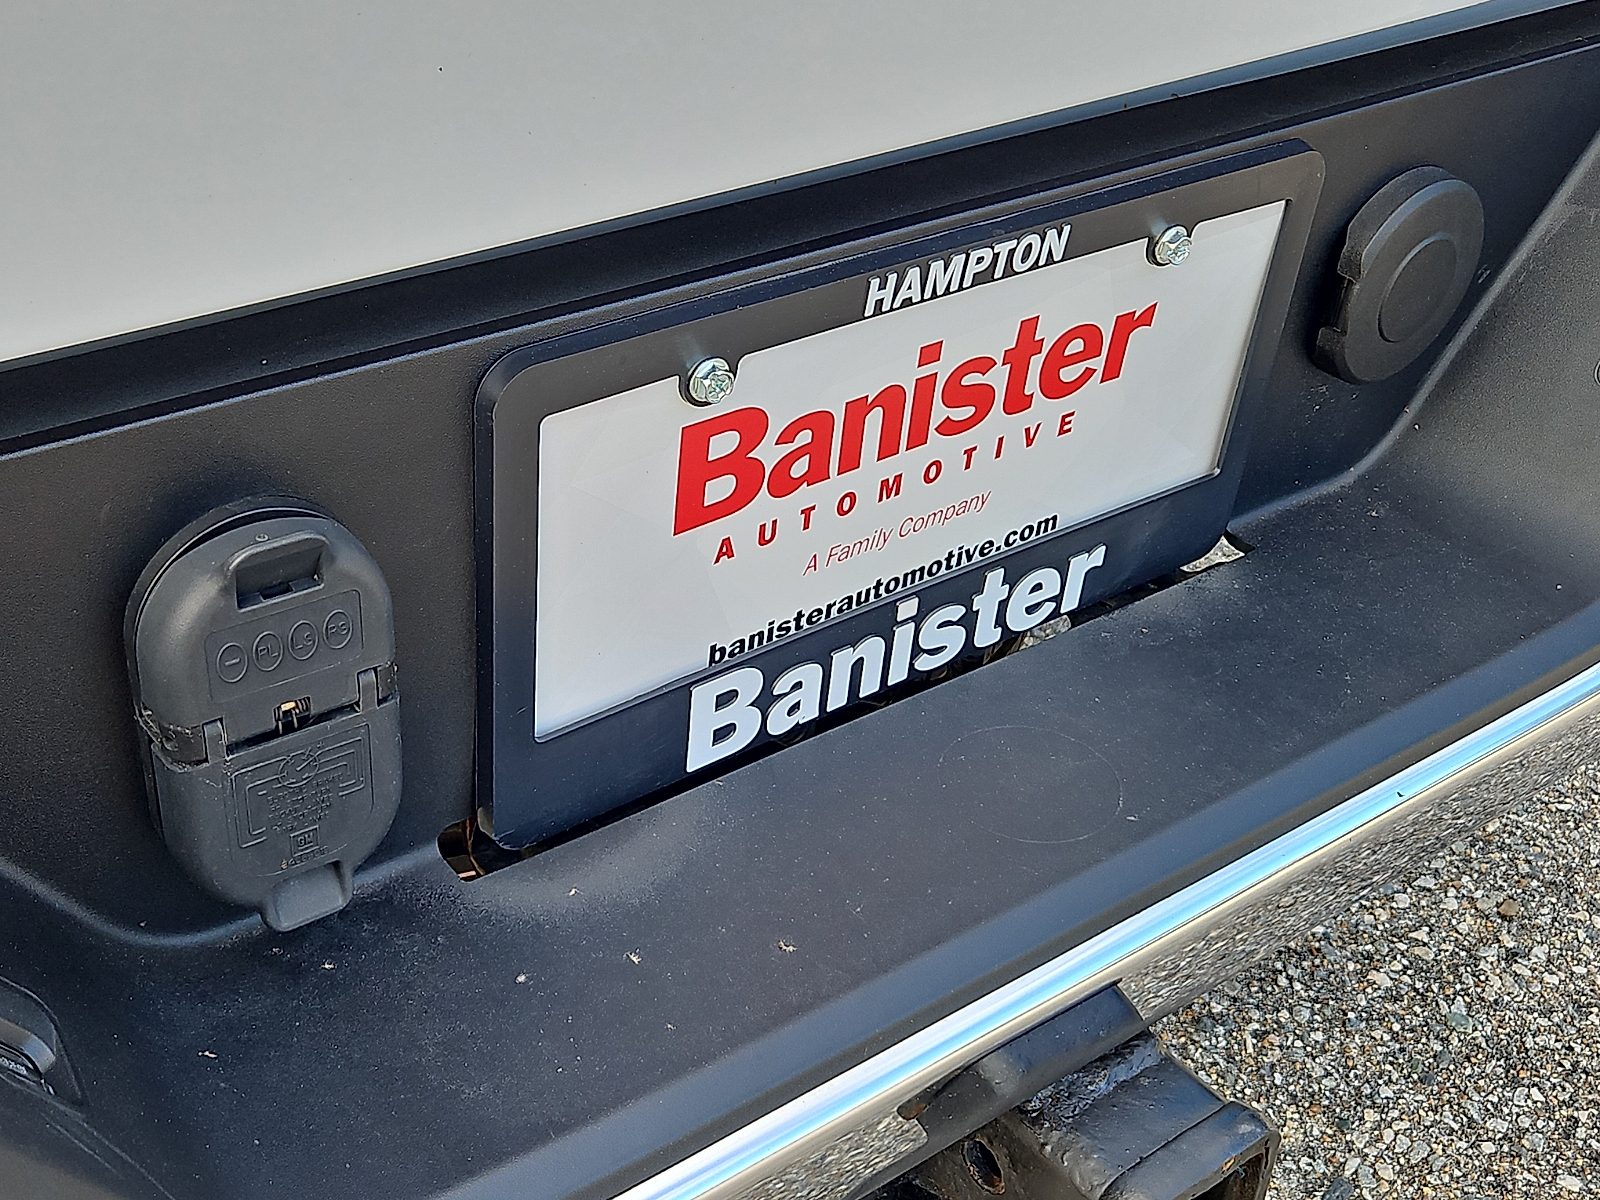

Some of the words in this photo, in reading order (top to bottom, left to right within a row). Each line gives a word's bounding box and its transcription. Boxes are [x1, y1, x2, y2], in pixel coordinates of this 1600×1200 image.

[863, 223, 1072, 318] HAMPTON
[673, 301, 1158, 537] Banister
[713, 410, 1077, 565] AUTOMOTIVE
[707, 513, 1059, 668] banisterautomotive.com
[802, 553, 819, 577] A
[825, 525, 894, 570] Family
[898, 489, 992, 539] Company
[685, 543, 1108, 774] Banister
